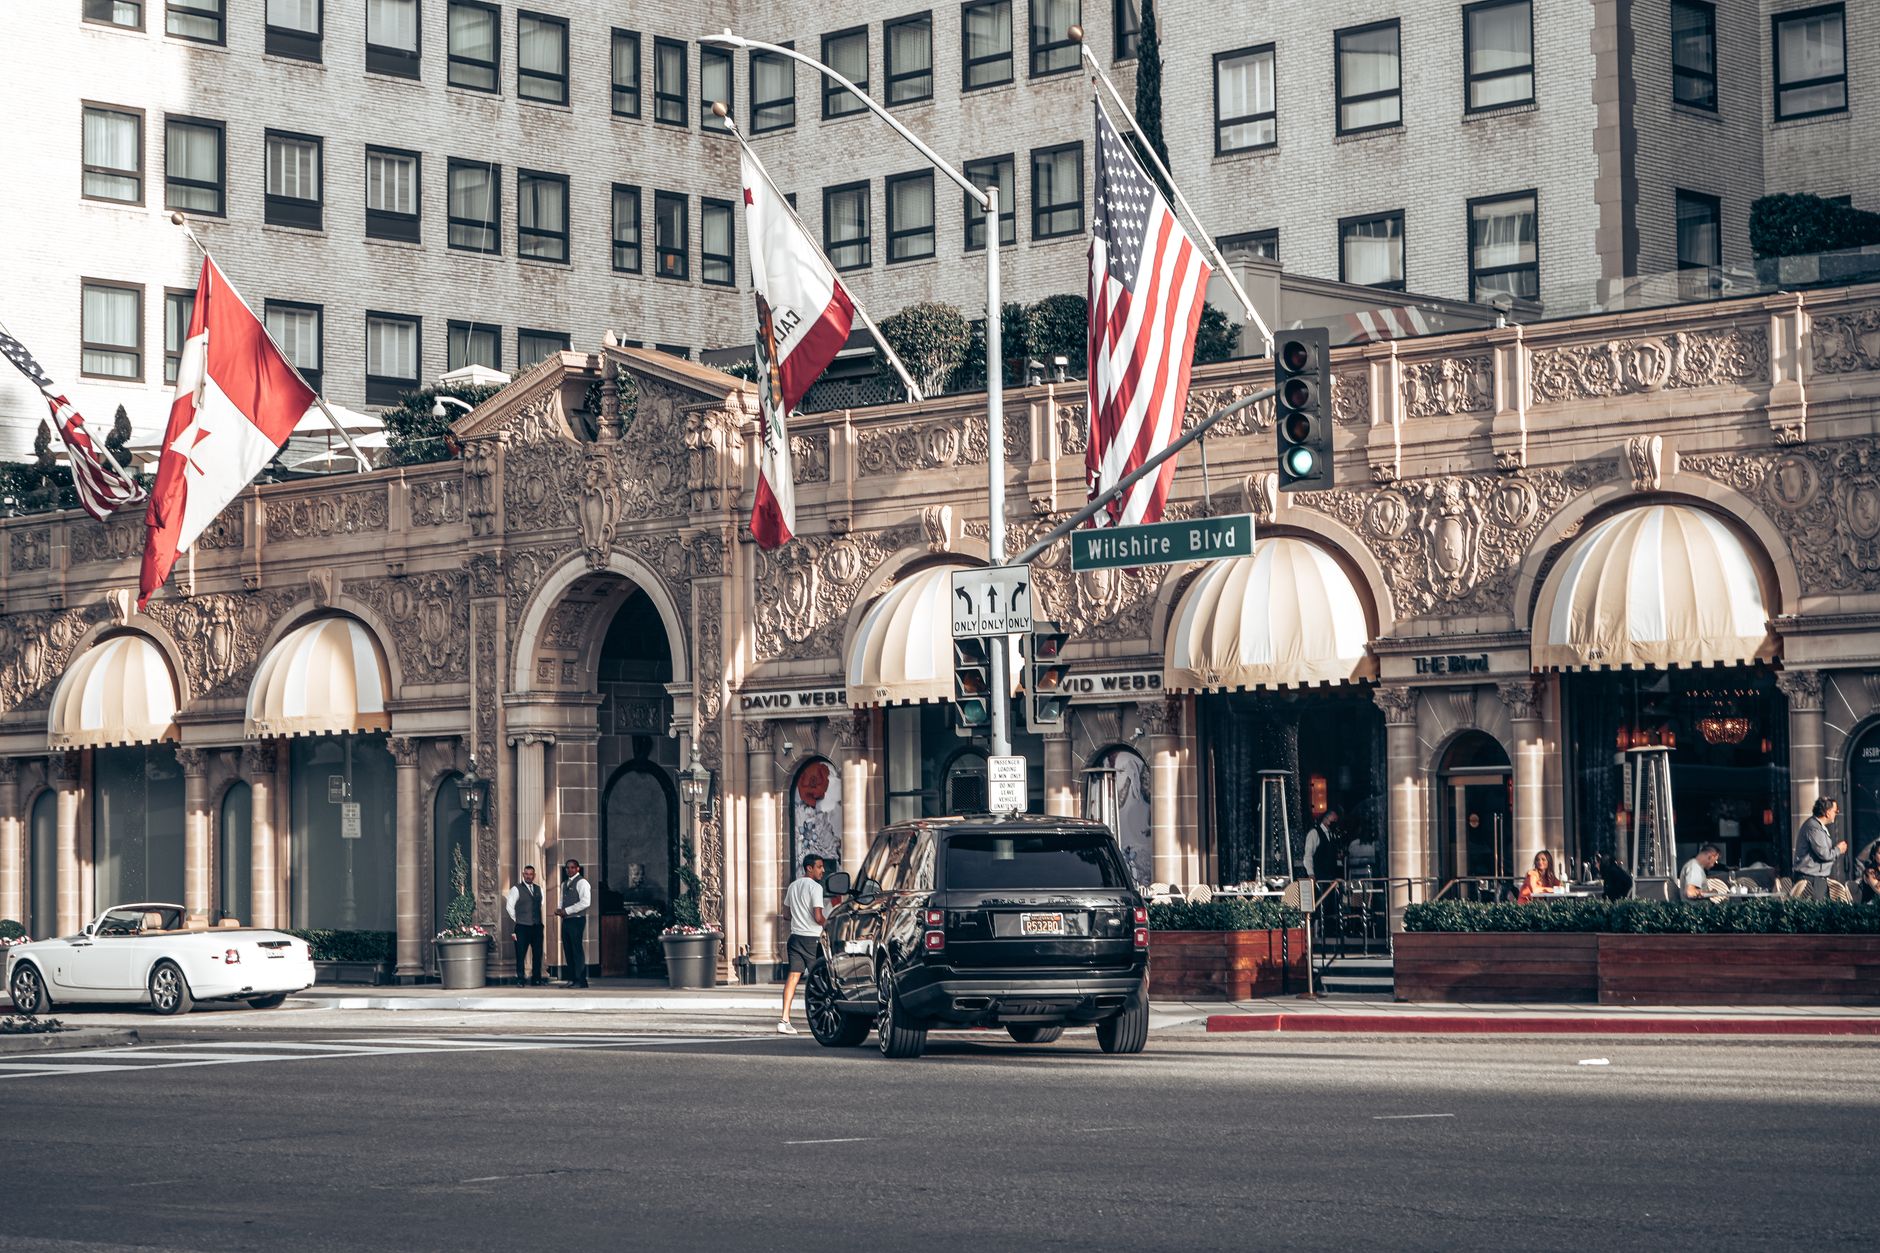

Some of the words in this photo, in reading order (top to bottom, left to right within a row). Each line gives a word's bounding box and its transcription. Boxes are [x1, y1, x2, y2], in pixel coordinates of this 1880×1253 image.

[1088, 534, 1170, 560] Wilshire
[1189, 526, 1235, 551] Blvd
[954, 621, 977, 631] ONLY
[981, 619, 1005, 630] ONLY
[1008, 617, 1030, 628] ONLY
[1412, 656, 1446, 674] THE
[1447, 653, 1489, 673] Blvd
[1063, 677, 1093, 693] VID
[1101, 674, 1162, 690] WEBB
[740, 694, 792, 710] DAVID
